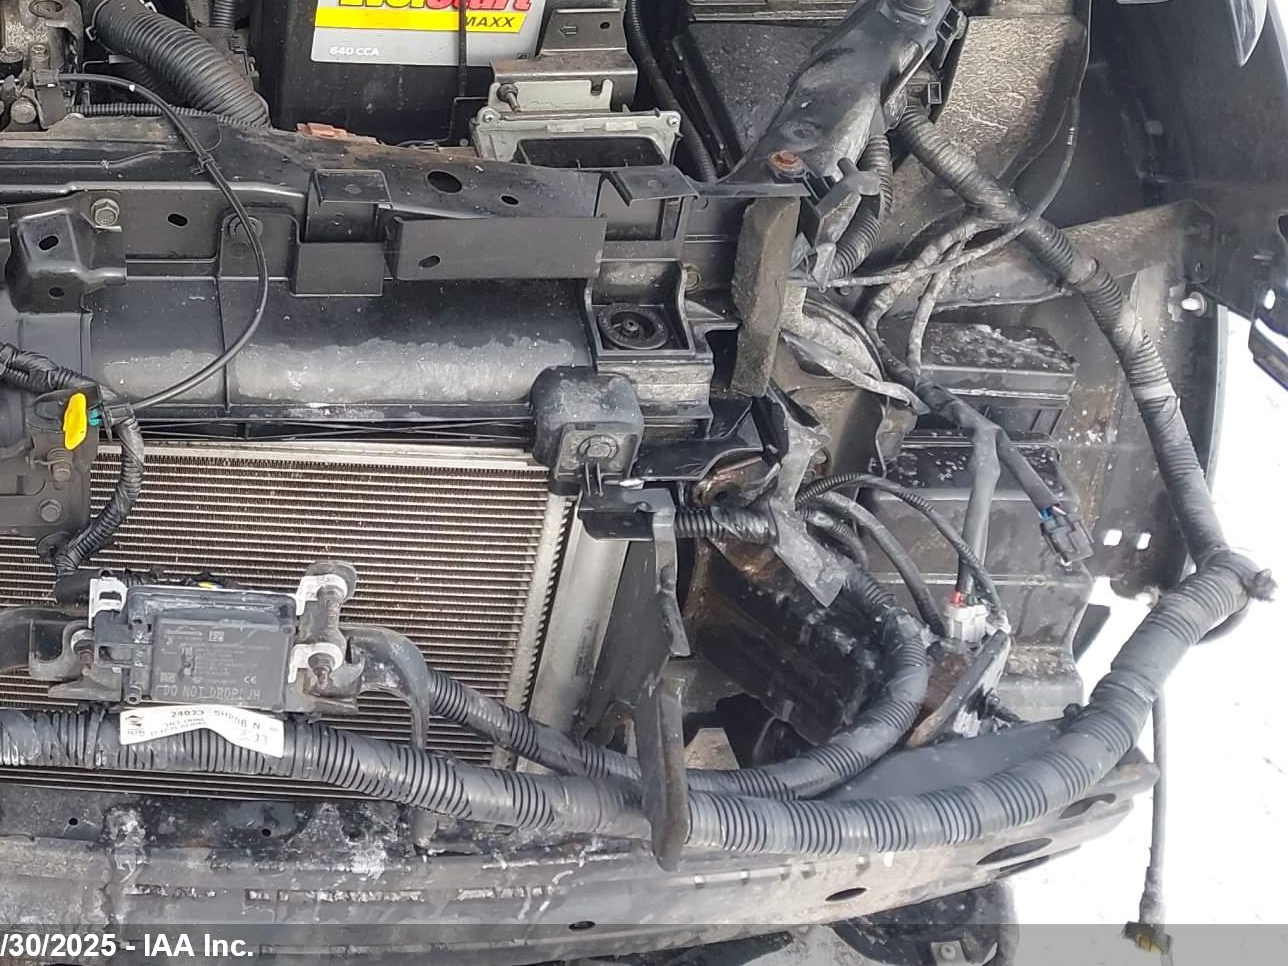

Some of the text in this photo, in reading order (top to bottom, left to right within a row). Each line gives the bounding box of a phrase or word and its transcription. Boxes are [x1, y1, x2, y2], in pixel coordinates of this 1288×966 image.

[464, 15, 516, 28] MAXX
[329, 46, 380, 58] 640 CCA
